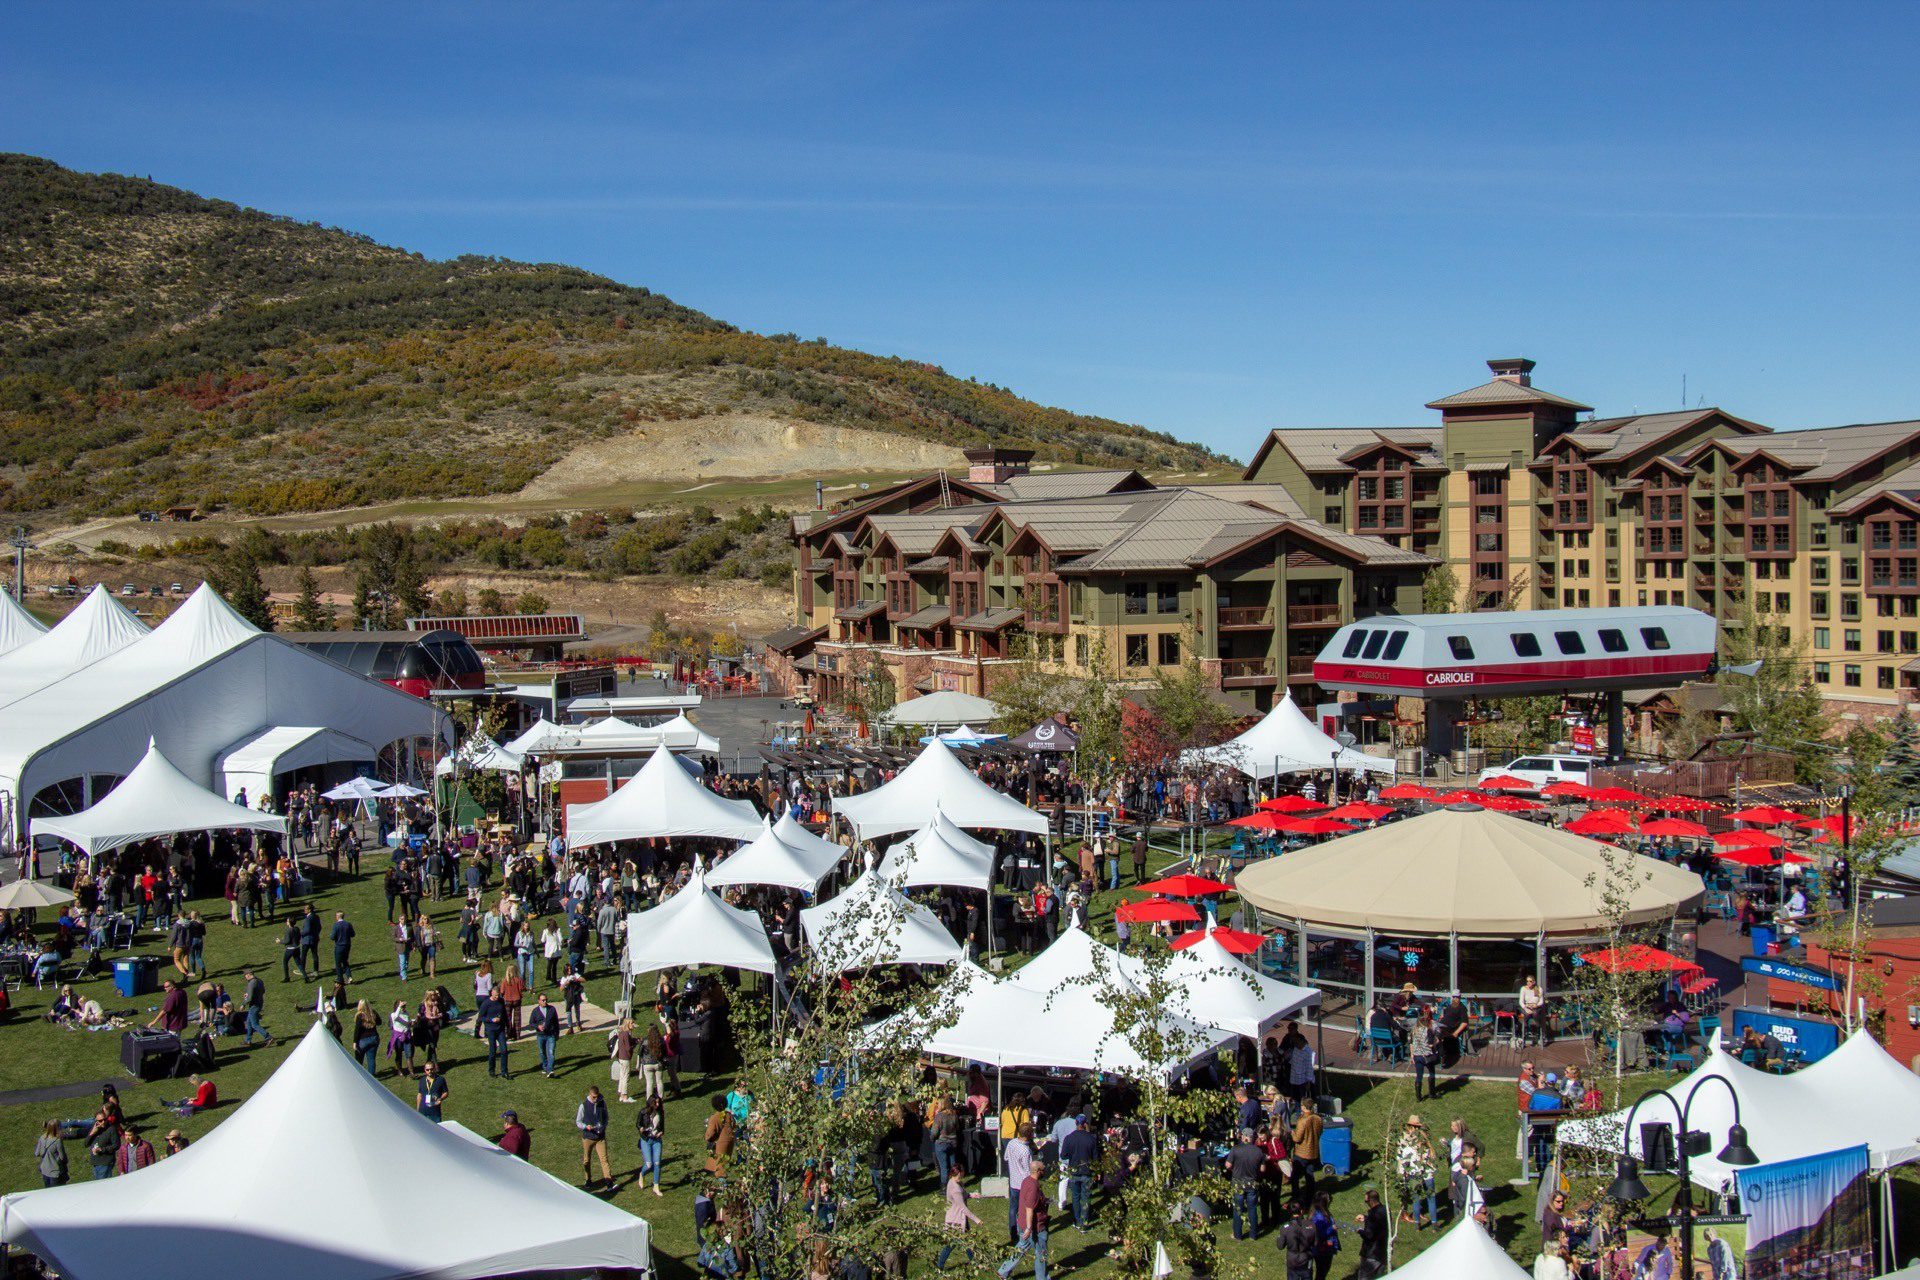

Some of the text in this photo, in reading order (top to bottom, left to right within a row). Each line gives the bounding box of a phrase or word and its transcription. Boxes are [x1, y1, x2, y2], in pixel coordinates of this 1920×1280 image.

[1356, 670, 1390, 680] CABRIOLET
[1426, 672, 1474, 684] CABRIOLET
[1772, 1025, 1794, 1035] BUD
